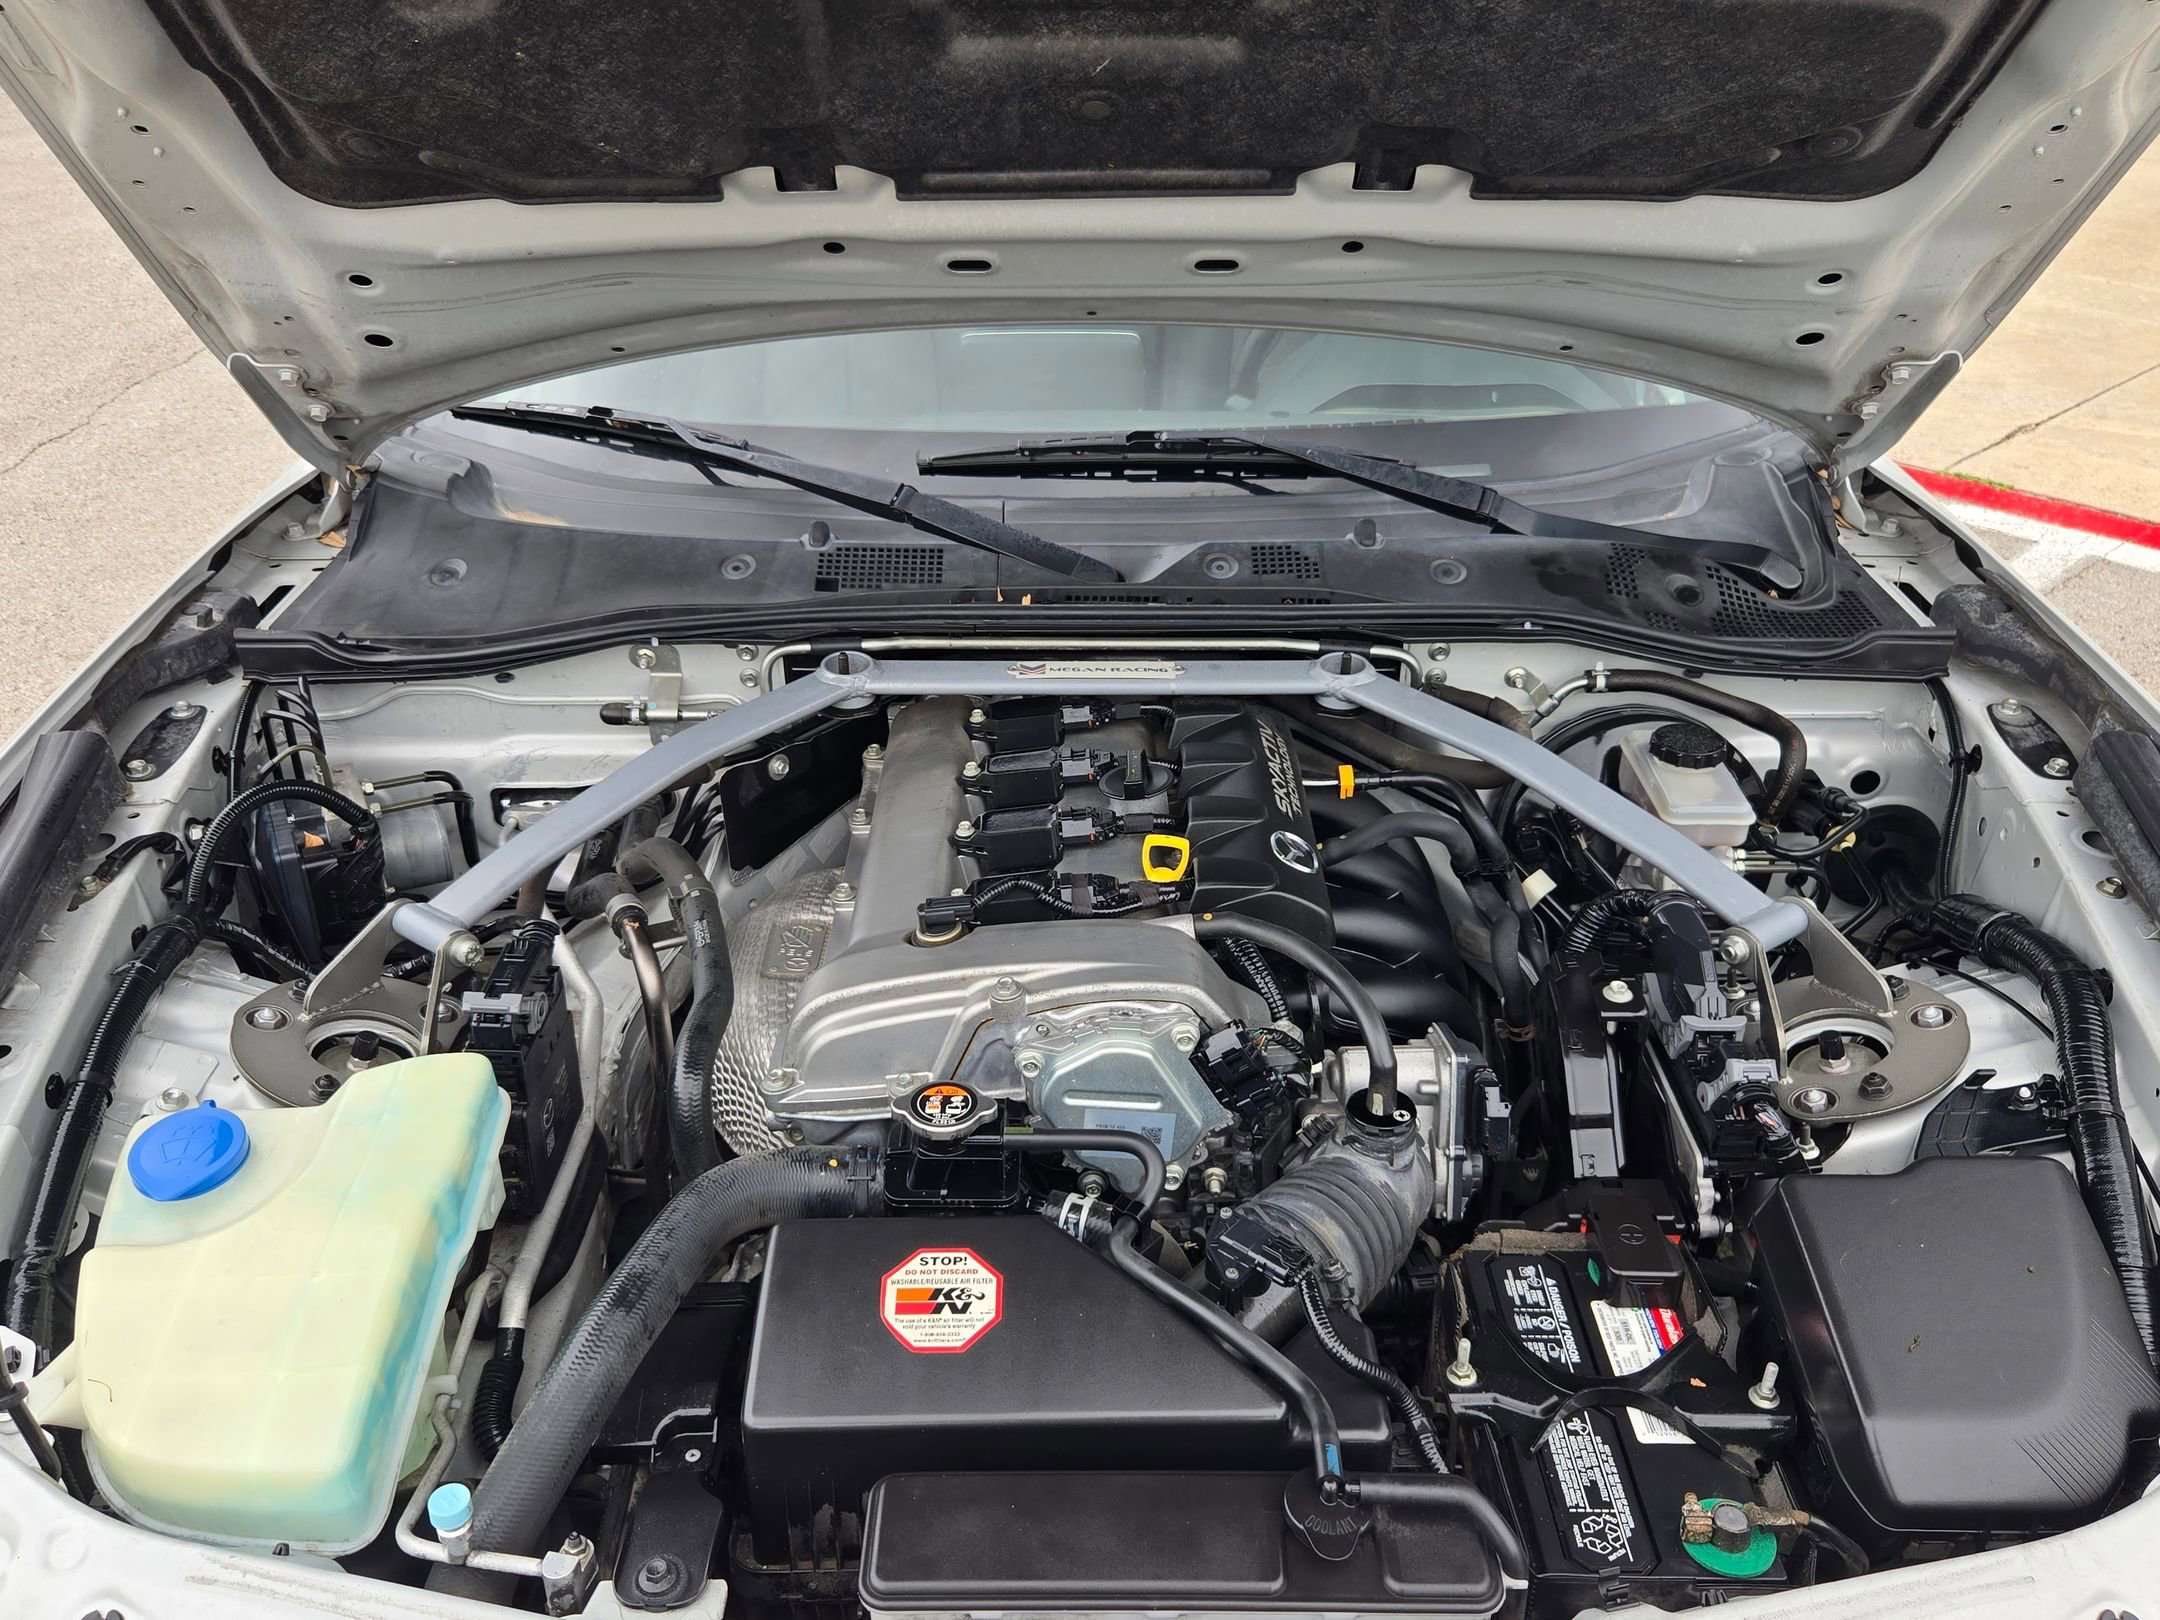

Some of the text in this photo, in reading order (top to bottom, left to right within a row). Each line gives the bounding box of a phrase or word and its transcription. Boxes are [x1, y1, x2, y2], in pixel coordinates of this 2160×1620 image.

[1257, 718, 1293, 822] SKYACTIV
[1274, 731, 1302, 817] TECHNOLOGY
[920, 1256, 968, 1266] STOP!
[1548, 1286, 1568, 1322] DANGER
[1562, 1330, 1581, 1362] POISON
[1576, 1458, 1586, 1472] HELP
[1580, 1472, 1591, 1487] FAST
[1586, 1469, 1596, 1480] GET
[1304, 1514, 1358, 1536] COOLANT
[1602, 1513, 1618, 1524] LEAD
